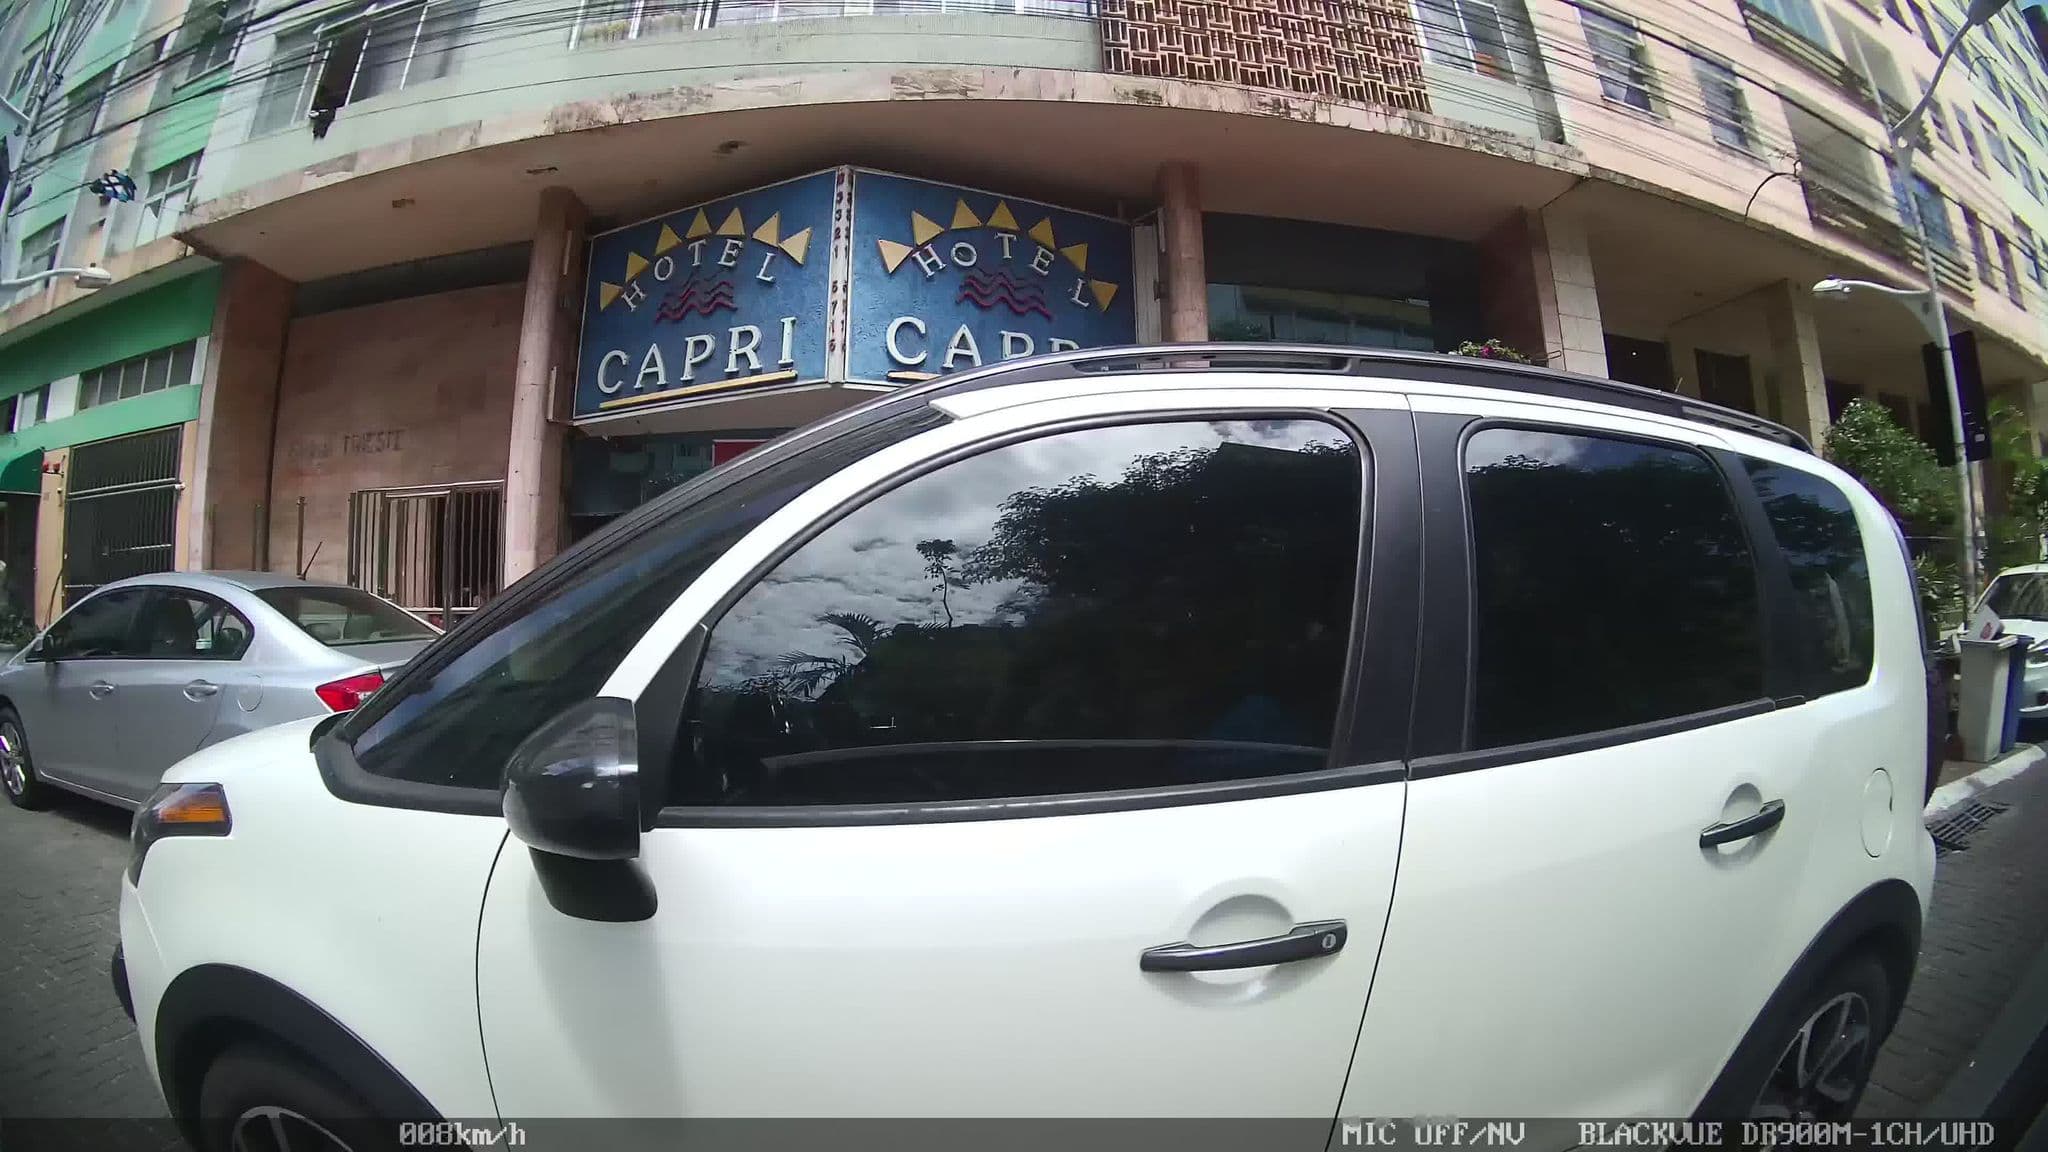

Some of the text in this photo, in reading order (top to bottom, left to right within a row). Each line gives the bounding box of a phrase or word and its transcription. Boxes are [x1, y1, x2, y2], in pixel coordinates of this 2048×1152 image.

[621, 240, 777, 311] HOTEL
[912, 232, 1091, 307] HOTEL
[596, 316, 797, 394] CAPRI
[885, 315, 1081, 369] CAP
